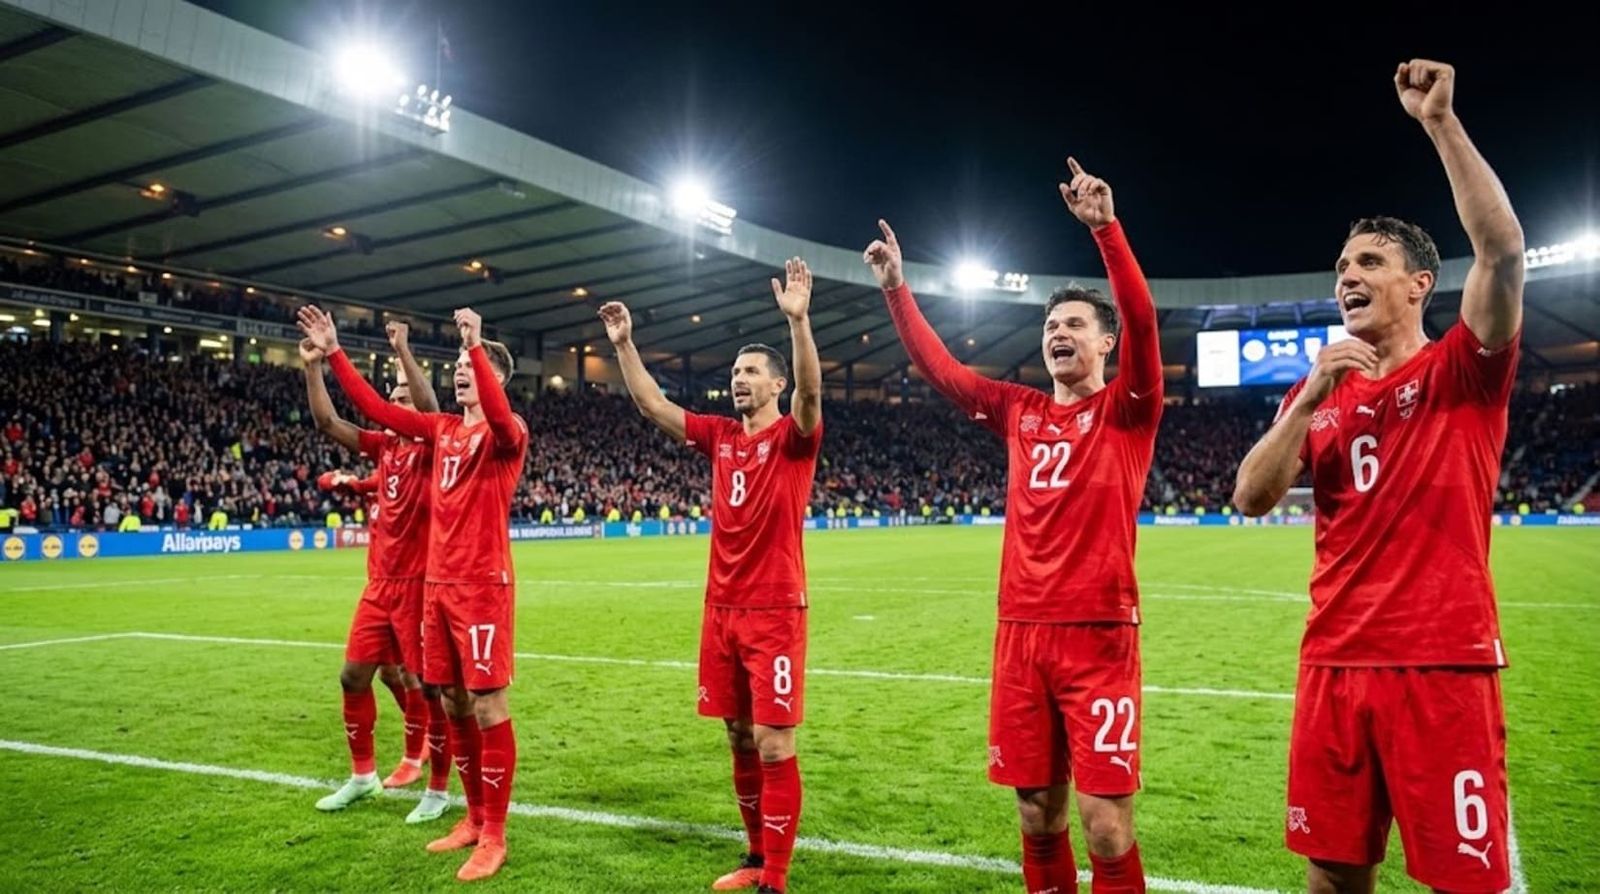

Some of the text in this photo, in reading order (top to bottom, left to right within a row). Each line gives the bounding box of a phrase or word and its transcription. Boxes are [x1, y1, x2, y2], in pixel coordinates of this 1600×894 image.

[439, 456, 462, 490] 17
[1029, 441, 1071, 489] 22
[1350, 434, 1380, 493] 6
[387, 475, 399, 499] 3
[729, 470, 746, 507] 8
[468, 624, 495, 660] 17
[773, 655, 792, 695] 8
[1091, 697, 1137, 752] 22
[1453, 769, 1488, 840] 6
